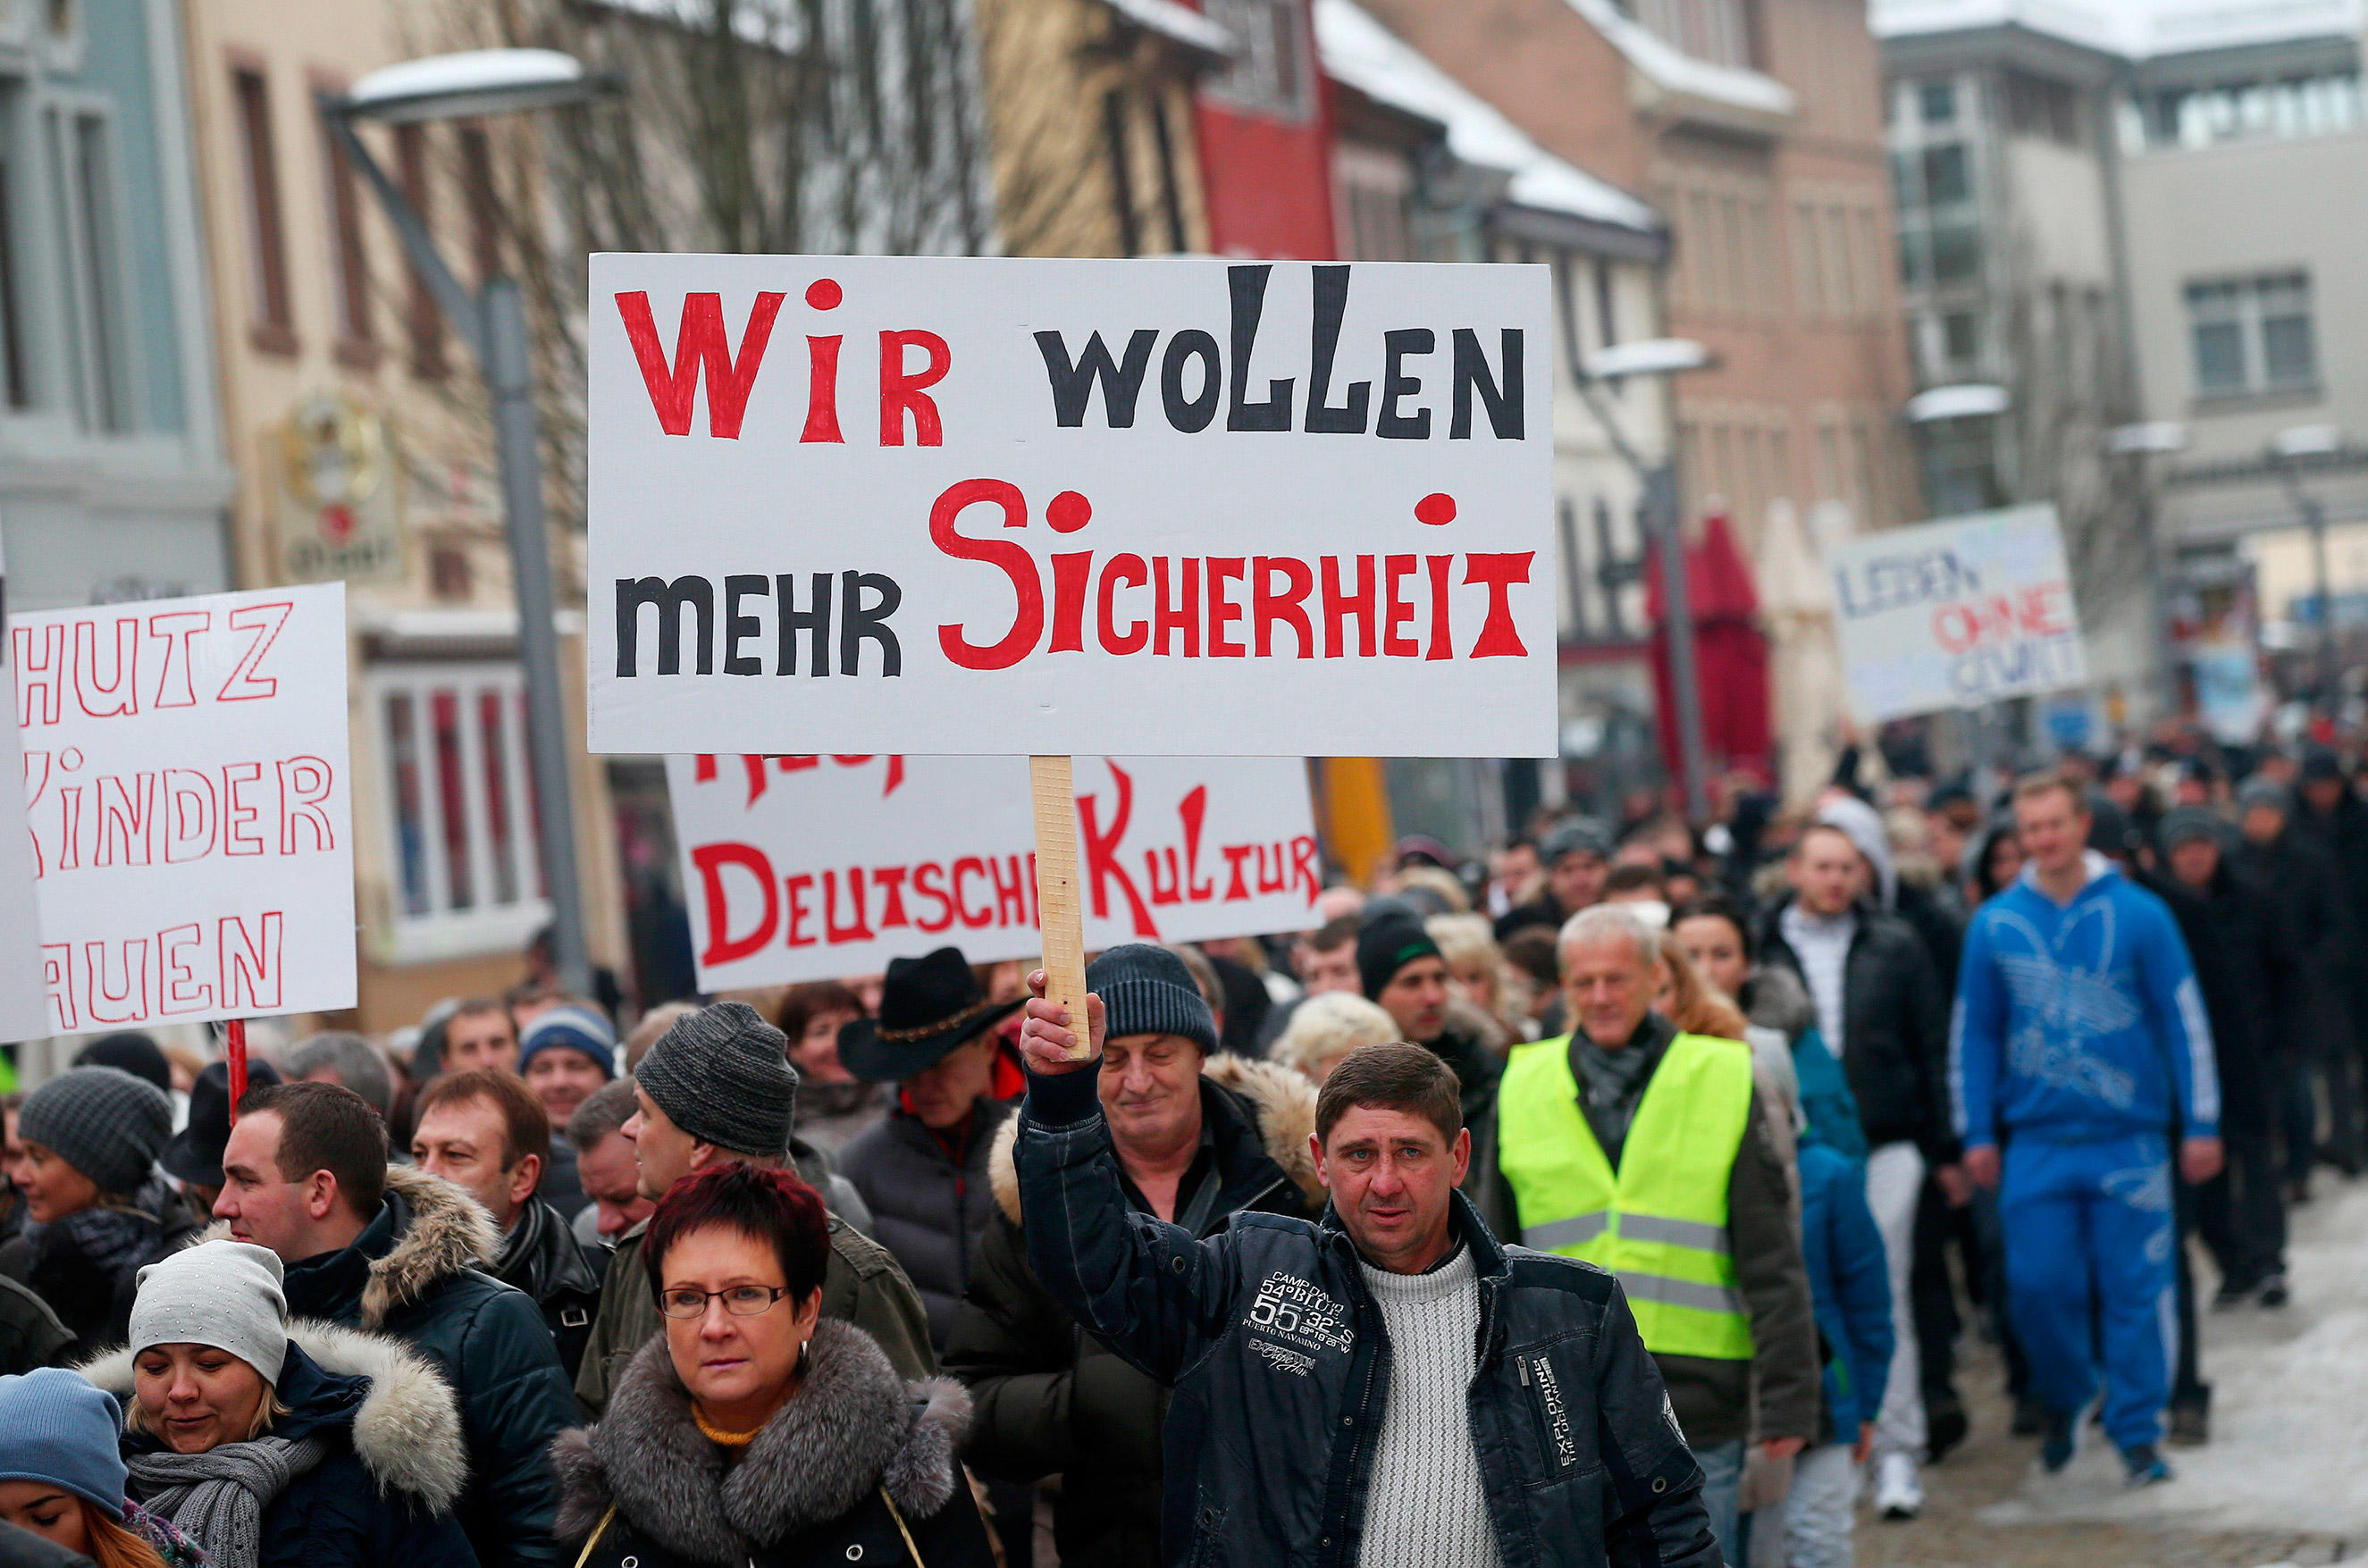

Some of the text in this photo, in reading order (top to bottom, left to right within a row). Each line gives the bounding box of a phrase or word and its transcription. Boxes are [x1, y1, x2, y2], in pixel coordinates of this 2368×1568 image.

[1033, 264, 1526, 440] WOLLEN
[1076, 757, 1323, 940] KULTUR
[1272, 1270, 1310, 1288] CAMP
[1242, 1318, 1277, 1336] PUERTO
[1532, 1359, 1571, 1467] EXPLORING
[1551, 1385, 1577, 1463] THE OCEAN
